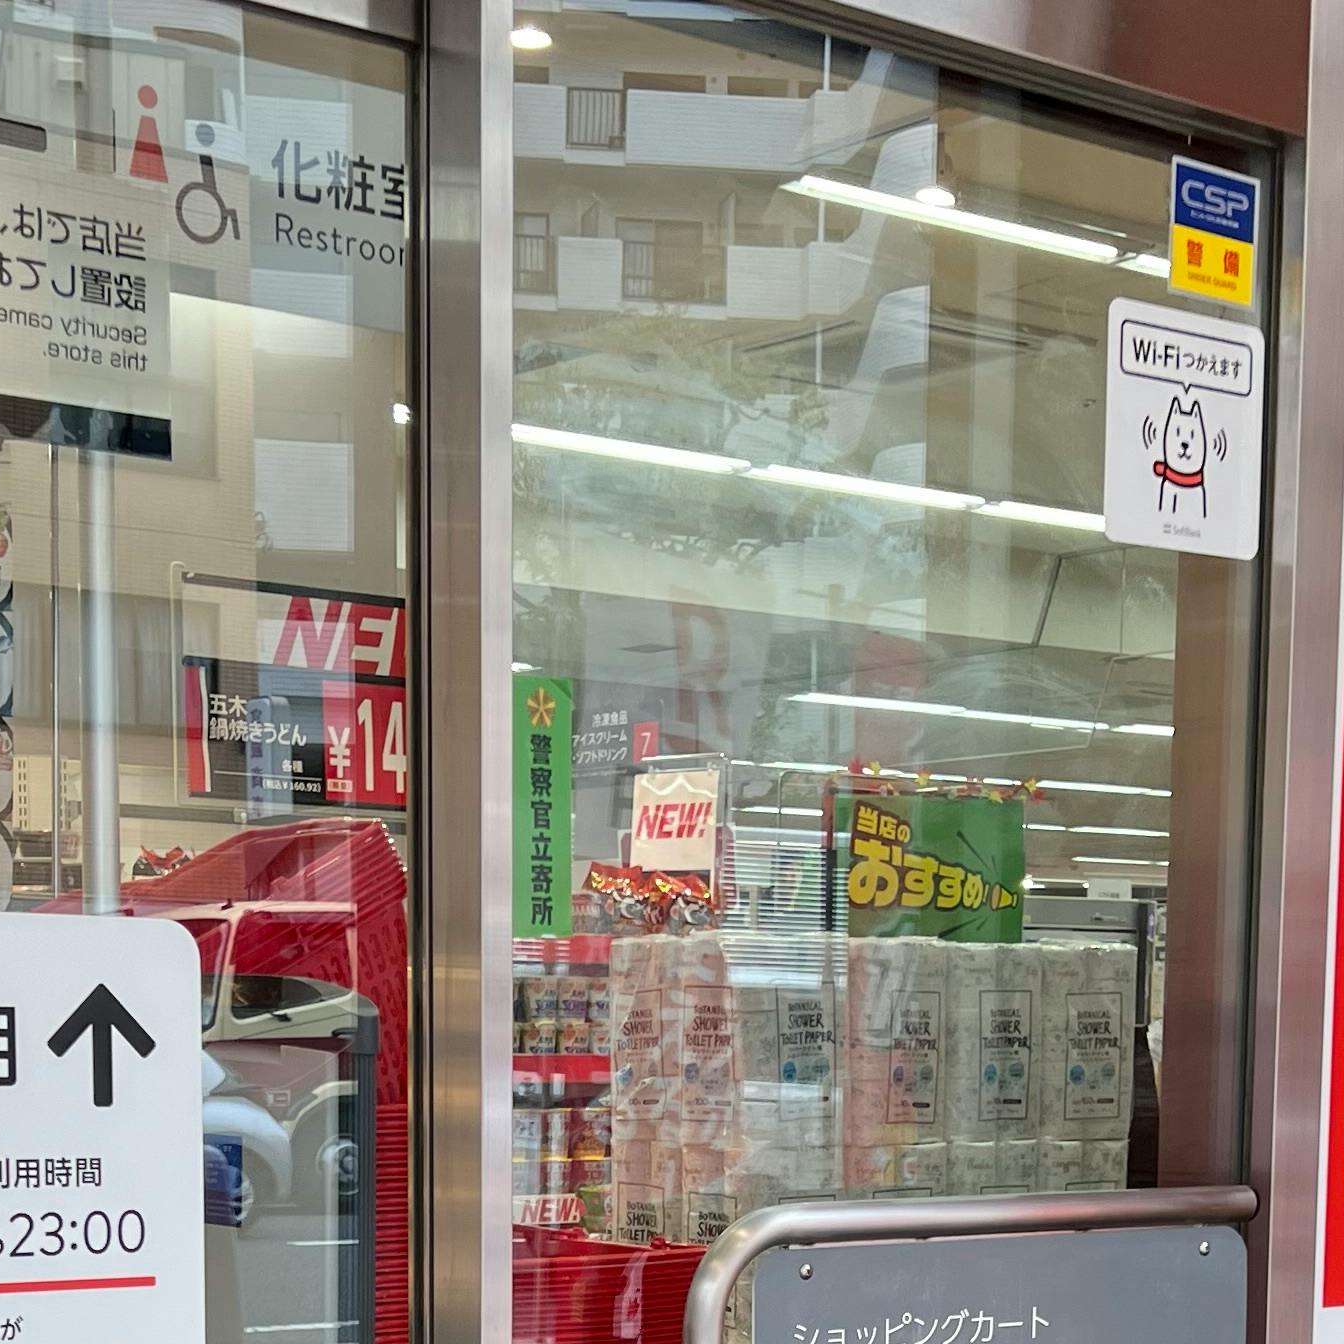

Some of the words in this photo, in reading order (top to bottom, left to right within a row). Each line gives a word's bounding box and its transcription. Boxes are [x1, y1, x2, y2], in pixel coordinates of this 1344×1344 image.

[1181, 179, 1250, 218] CSP
[272, 595, 406, 678] NE
[209, 693, 248, 716] 五木
[208, 717, 307, 747] 鍋焼きうどん
[327, 725, 351, 778] ¥
[640, 732, 652, 756] 7
[529, 733, 553, 926] 警察官立寄所
[634, 802, 714, 840] NEW!
[856, 805, 912, 844] 当店の
[788, 1012, 825, 1030] SHOWER
[805, 1030, 836, 1046] PAPER
[697, 1222, 730, 1238] SHOW
